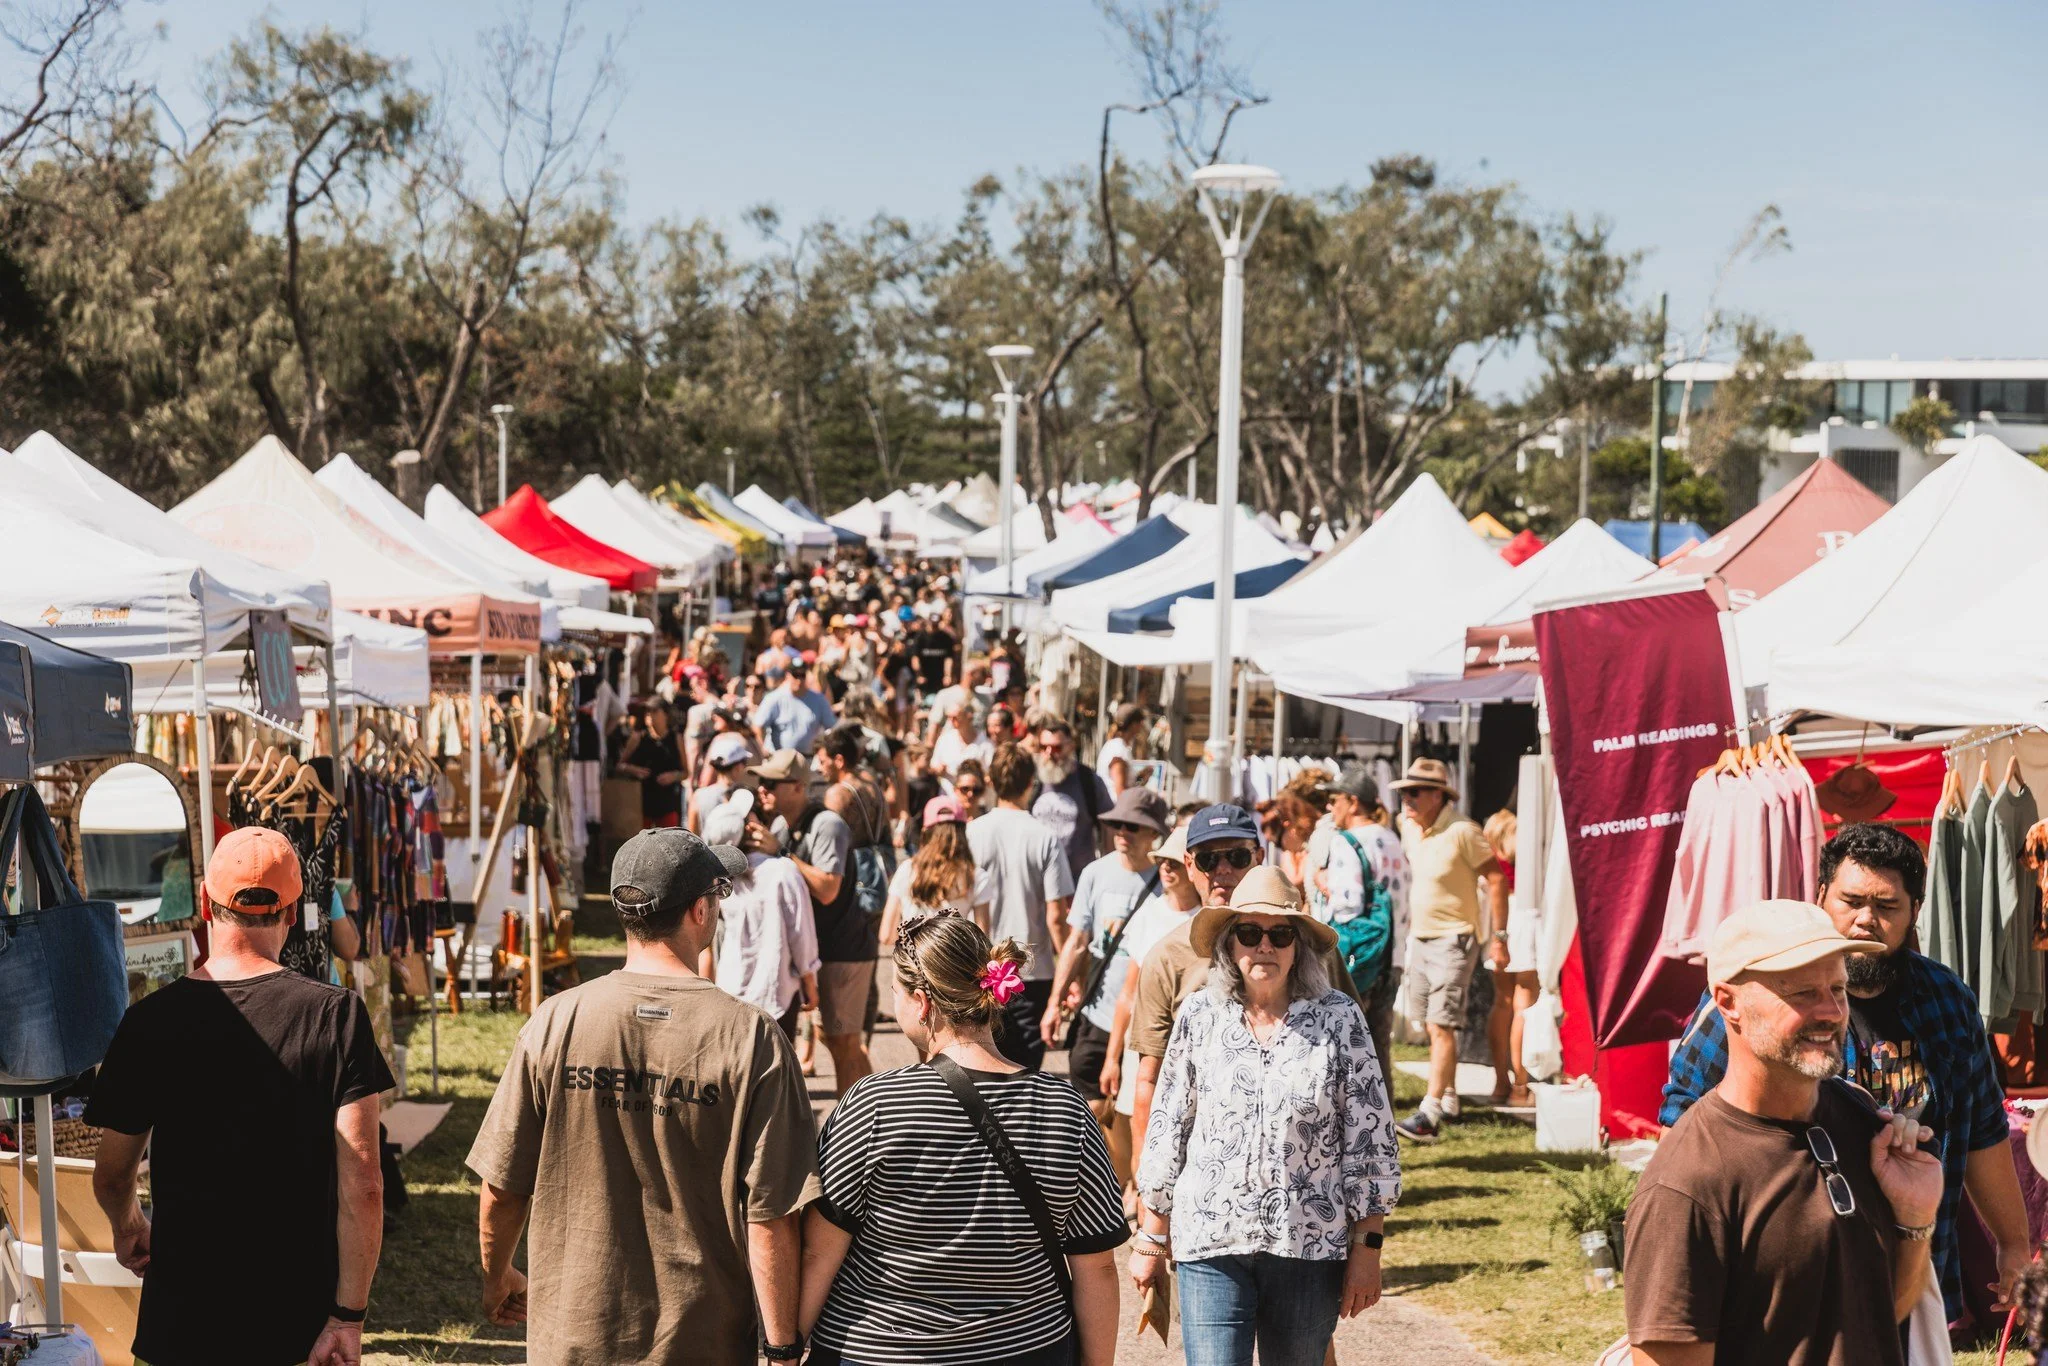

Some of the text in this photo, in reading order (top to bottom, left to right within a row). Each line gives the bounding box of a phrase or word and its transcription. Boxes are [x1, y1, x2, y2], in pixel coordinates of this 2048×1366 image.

[1593, 723, 1718, 753] PALM READINGS
[1580, 816, 1648, 838] PSYCHIC
[563, 1065, 720, 1107] ESSENTIALS
[602, 1096, 673, 1117] FEAR OF GOD
[980, 1113, 1020, 1175] PRADA
